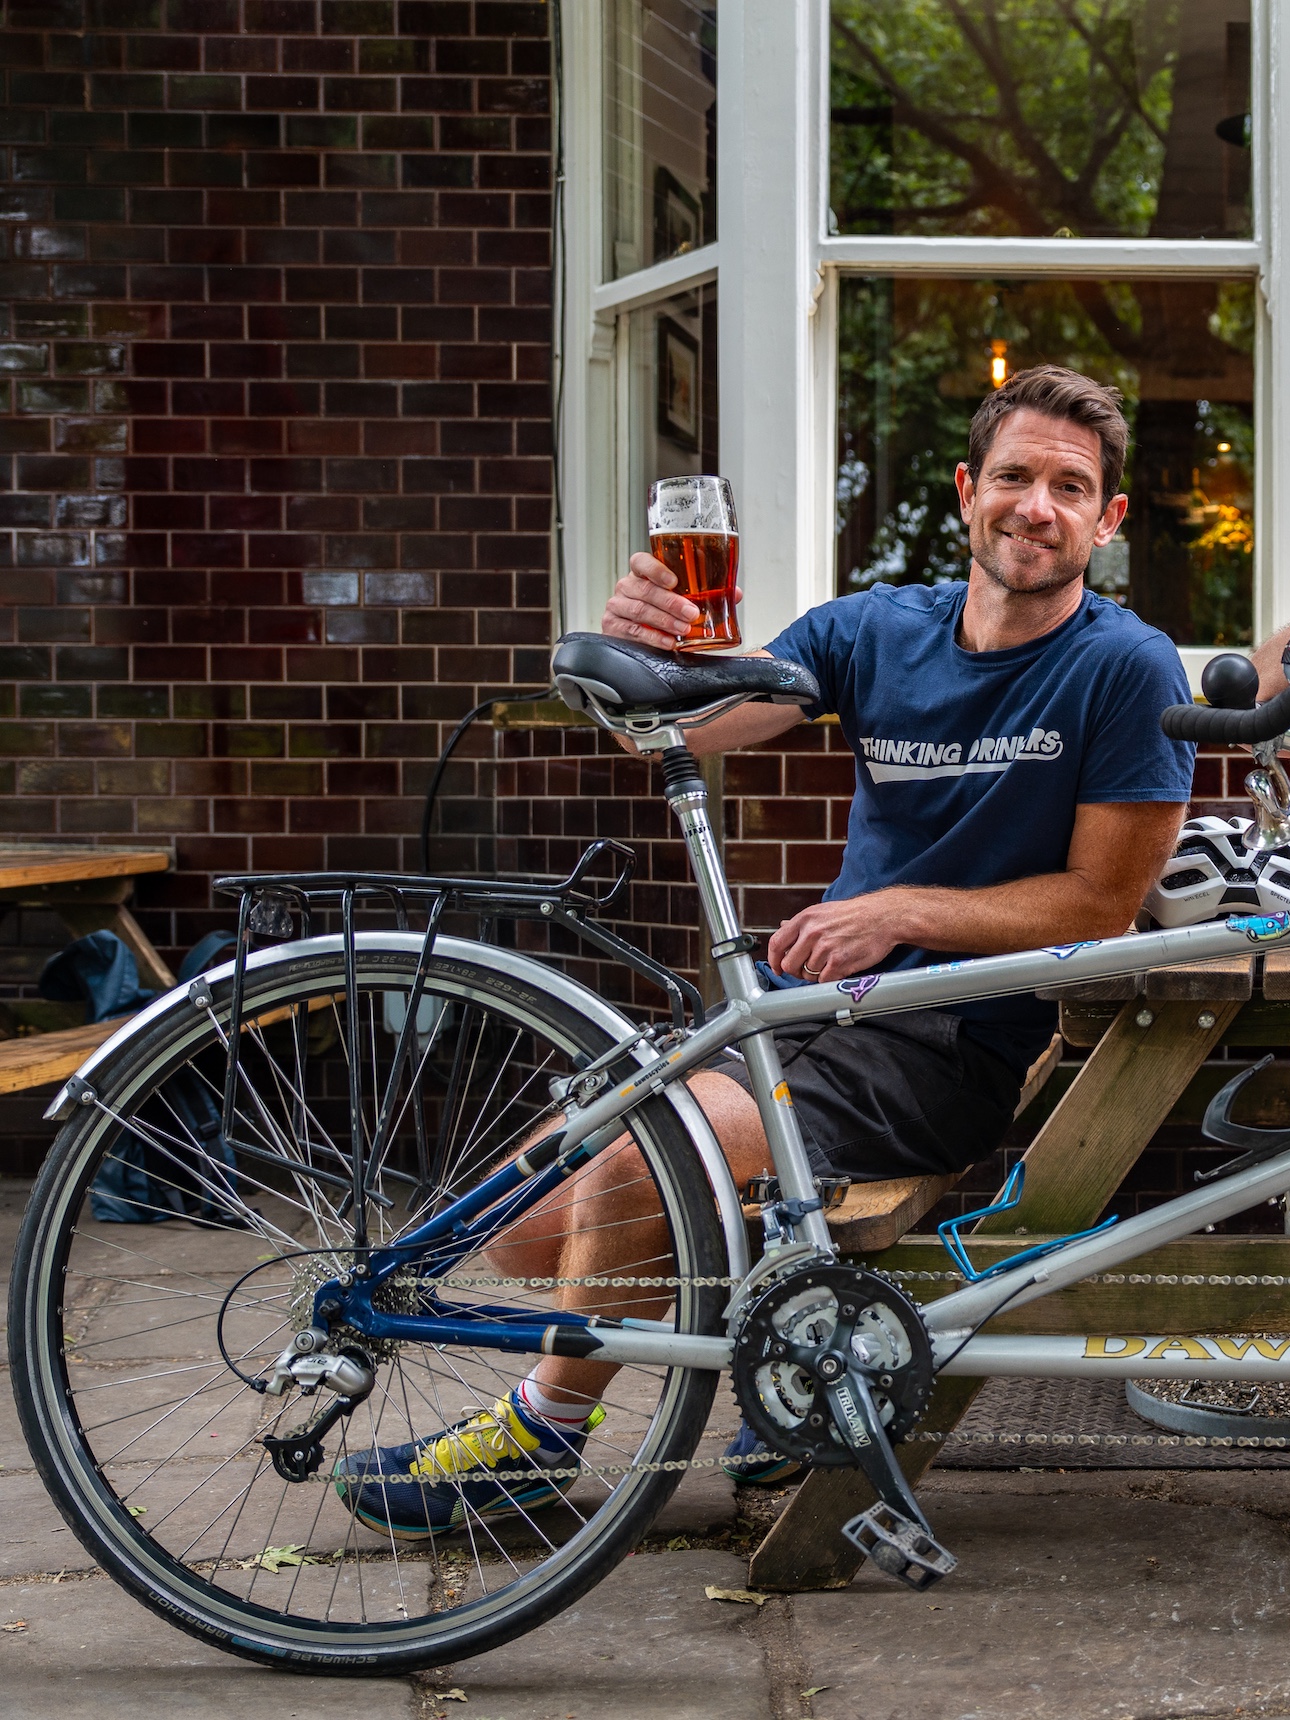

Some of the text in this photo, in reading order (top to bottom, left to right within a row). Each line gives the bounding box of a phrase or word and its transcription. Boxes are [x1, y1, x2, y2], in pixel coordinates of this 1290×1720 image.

[859, 737, 963, 766] THINKING
[836, 1387, 872, 1447] TRUVATIV
[148, 1591, 379, 1665] SCHWALBE MARATHON
